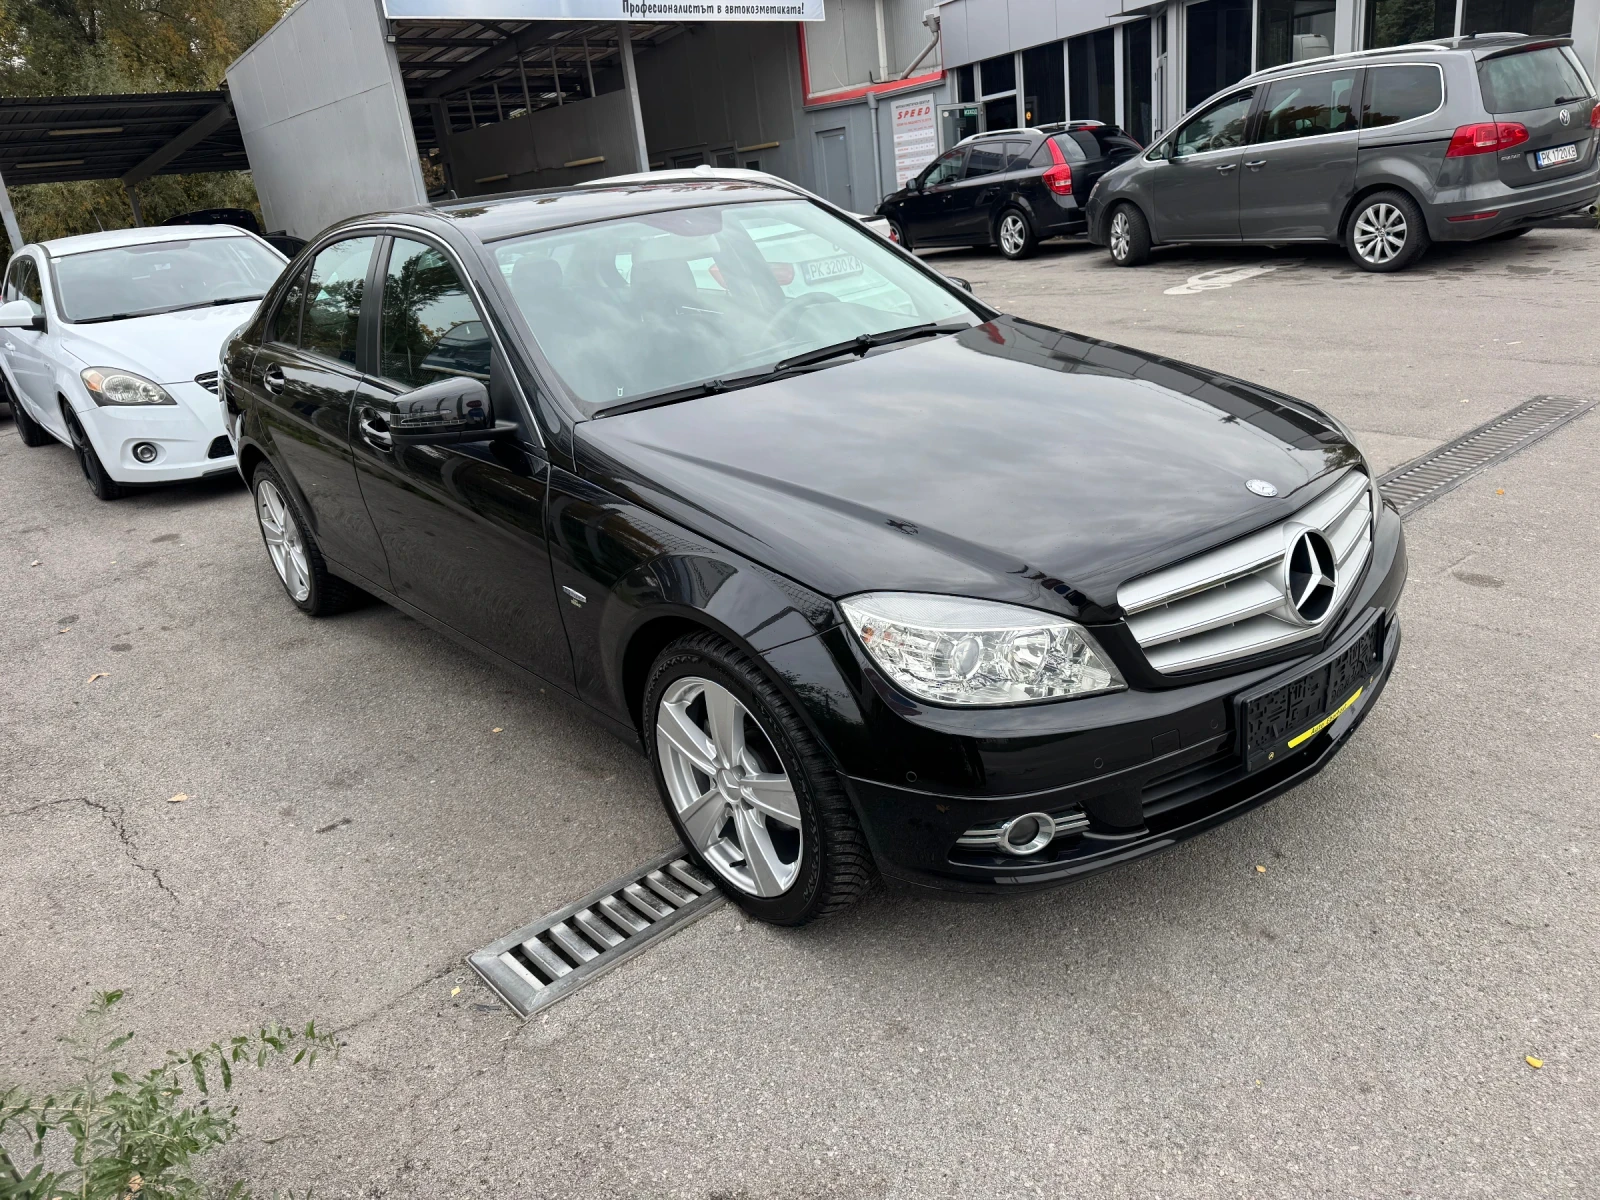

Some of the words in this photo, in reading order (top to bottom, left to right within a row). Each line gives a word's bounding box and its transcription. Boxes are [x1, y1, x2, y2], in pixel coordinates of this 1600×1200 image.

[622, 0, 714, 17] Професионалистът
[717, 5, 722, 14] в
[724, 3, 804, 15] автокозметиката!
[897, 106, 931, 120] SPEED
[1541, 151, 1552, 164] PK
[1552, 148, 1567, 161] 1720
[810, 263, 824, 278] PK
[825, 259, 847, 275] 3200
